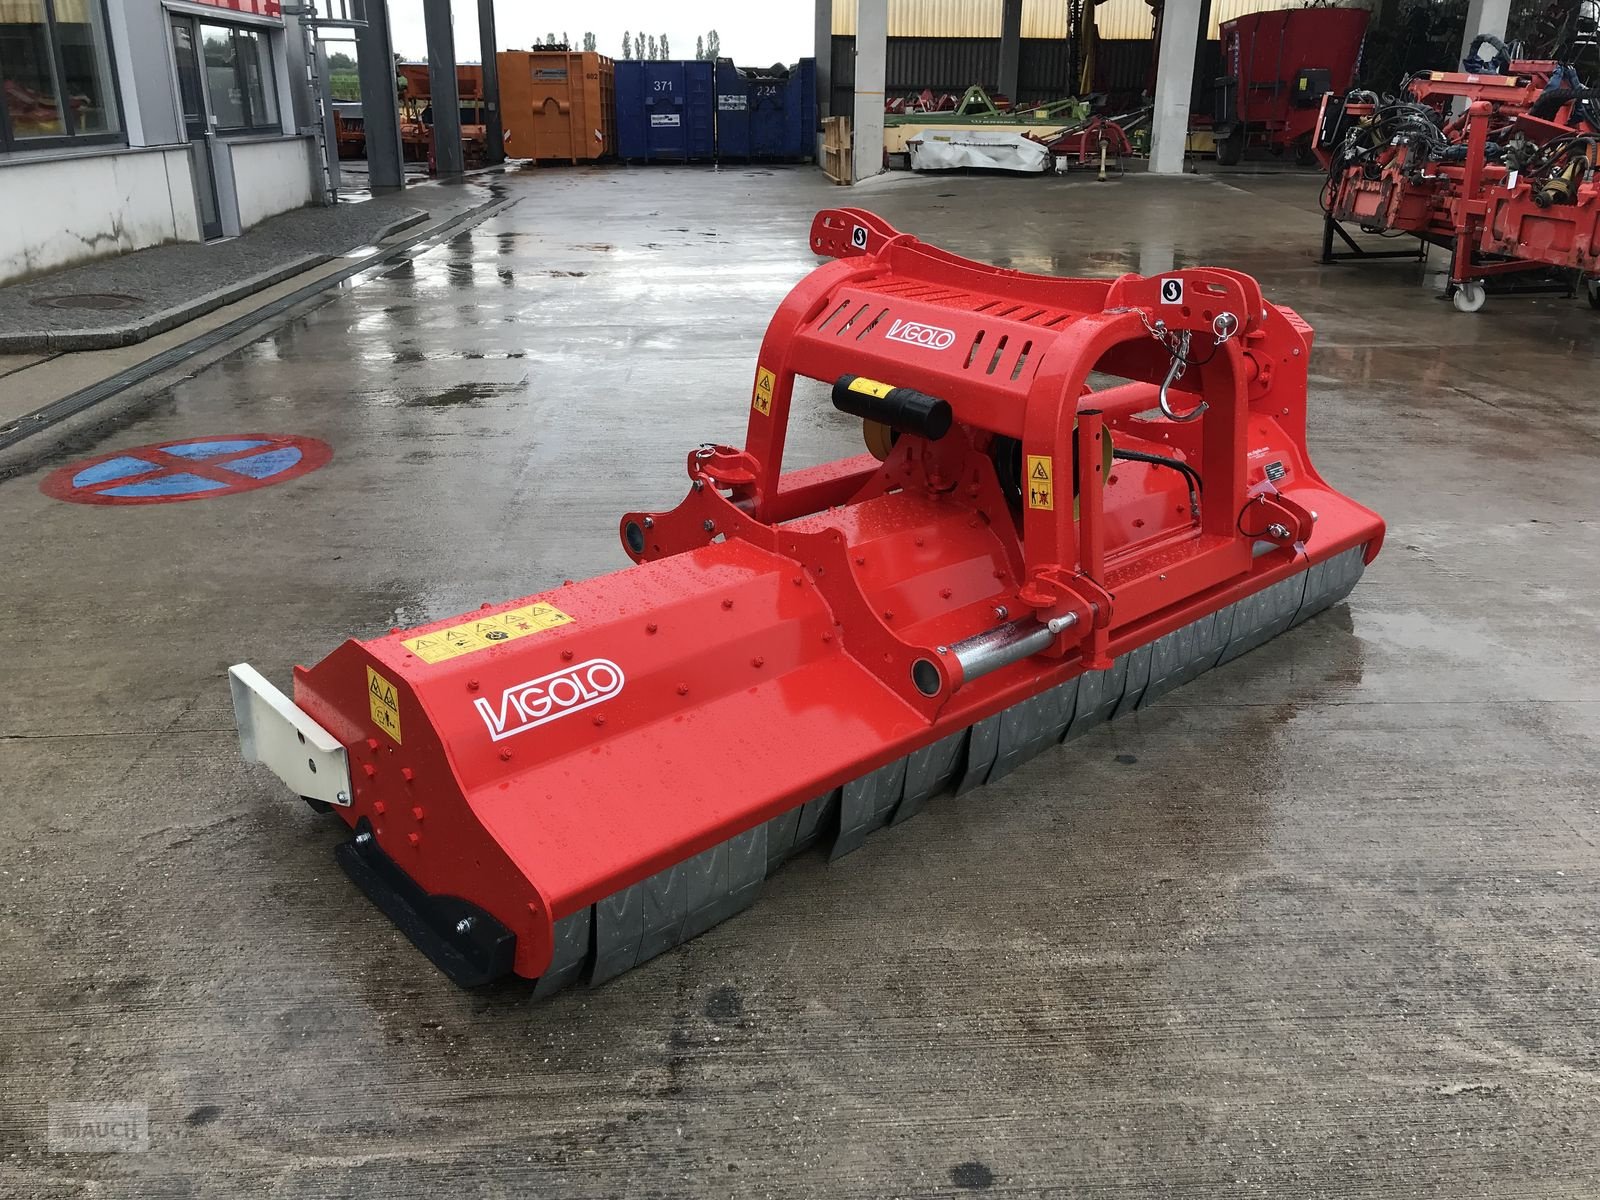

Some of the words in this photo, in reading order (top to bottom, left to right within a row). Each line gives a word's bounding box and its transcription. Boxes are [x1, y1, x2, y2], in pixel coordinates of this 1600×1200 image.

[653, 80, 673, 91] 371
[756, 85, 777, 96] 224
[885, 319, 955, 350] VIGOLO
[473, 660, 623, 741] VIGOLO
